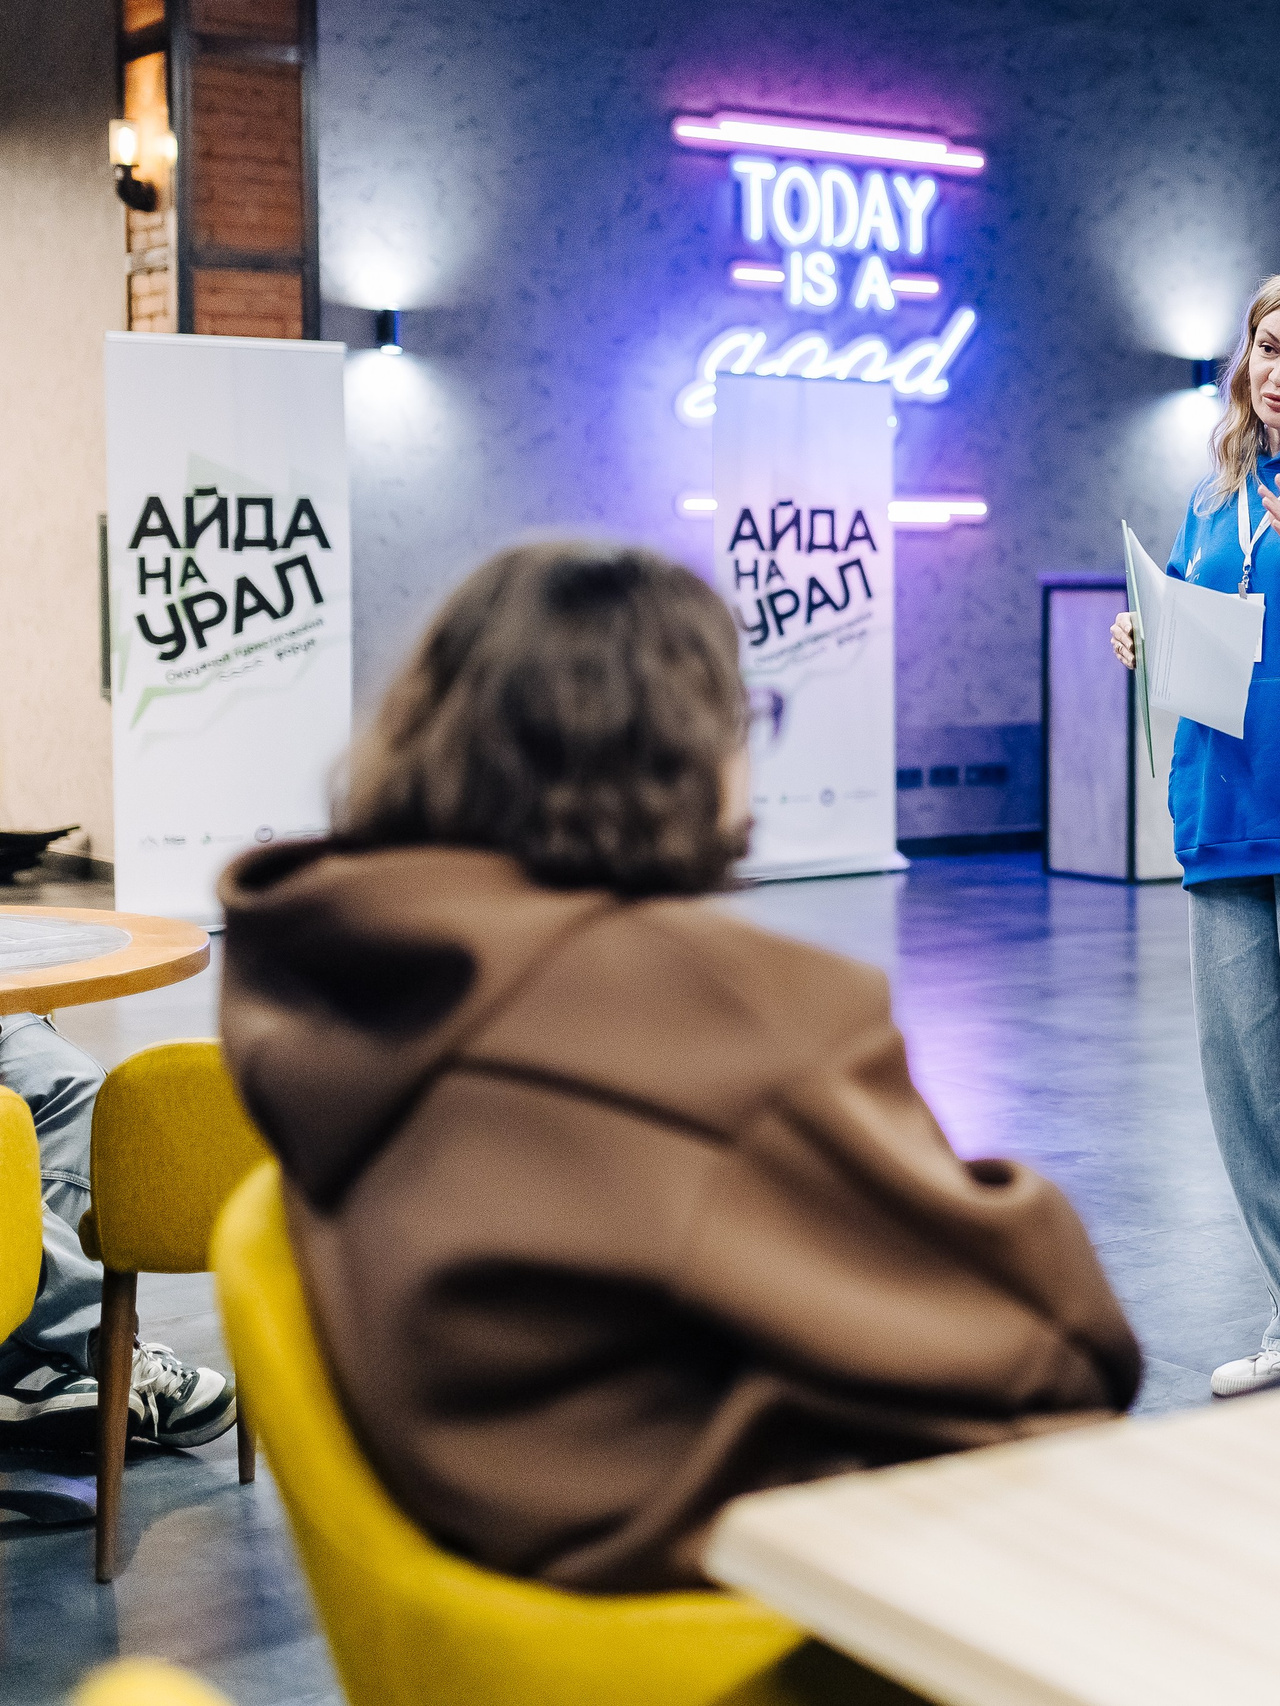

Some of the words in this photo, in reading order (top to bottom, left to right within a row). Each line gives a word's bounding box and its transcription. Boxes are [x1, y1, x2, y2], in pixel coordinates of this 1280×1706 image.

[732, 159, 936, 255] TODAY
[789, 250, 838, 306] IS
[853, 255, 896, 311] A
[128, 486, 332, 552] АЙДА
[727, 499, 878, 553] АЙДА
[138, 556, 208, 595] НА
[733, 557, 873, 647] УРАЛ
[734, 558, 785, 590] НА
[135, 553, 324, 662] УРАЛ
